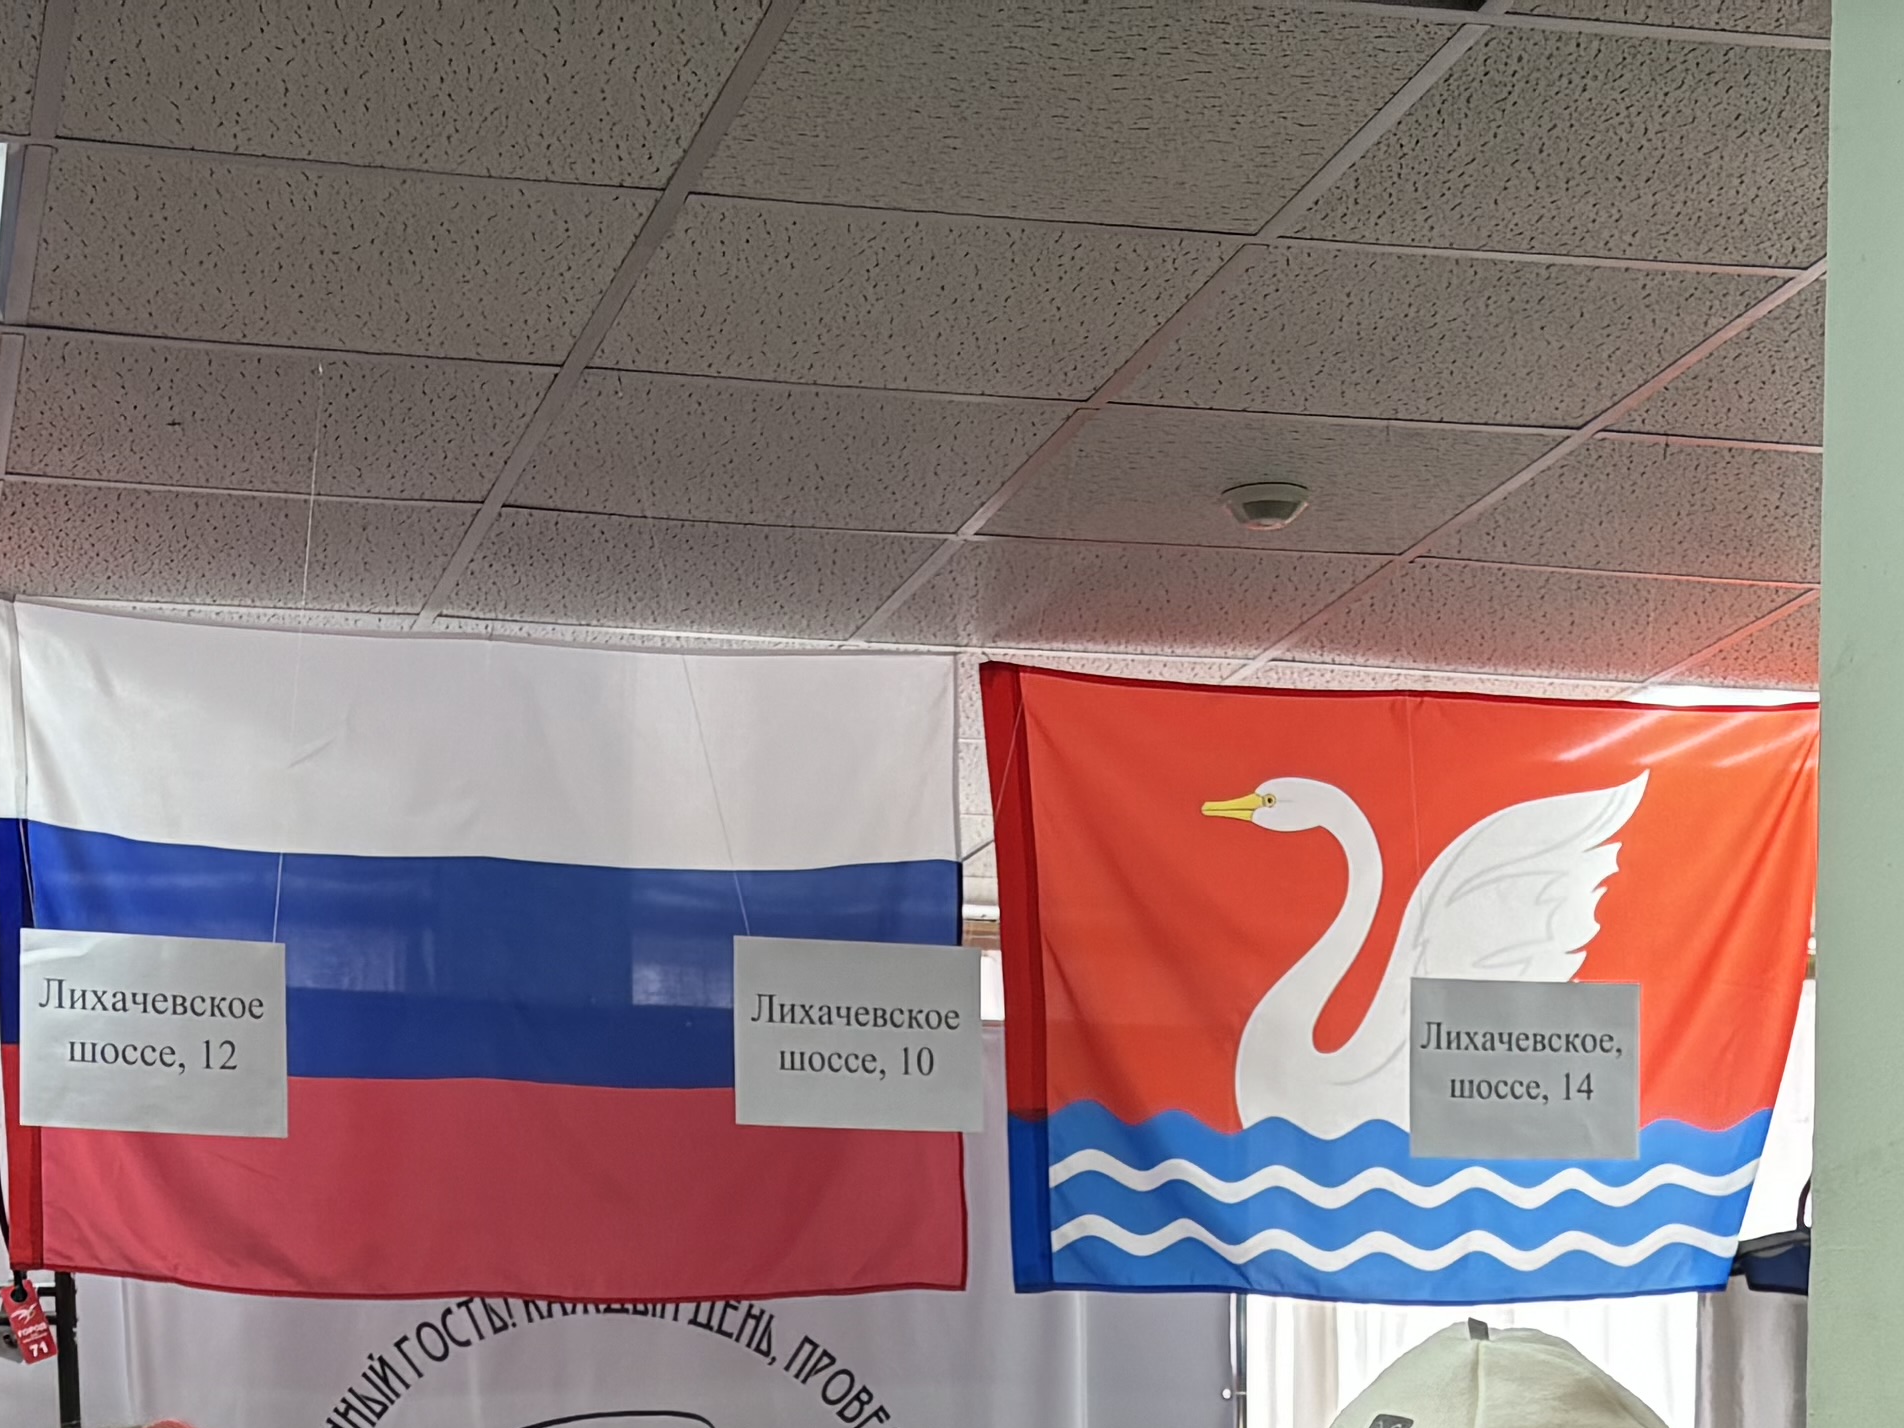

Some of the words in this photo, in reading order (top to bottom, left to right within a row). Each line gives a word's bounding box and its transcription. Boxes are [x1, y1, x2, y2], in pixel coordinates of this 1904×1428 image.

[38, 976, 266, 1021] Лихачевское
[750, 991, 961, 1033] Лихачевское
[66, 1039, 187, 1076] шоссе,
[199, 1038, 239, 1072] 12
[1420, 1021, 1622, 1059] Лихачевское,
[777, 1048, 889, 1080] шоссе,
[900, 1047, 936, 1077] 10
[1449, 1077, 1549, 1105] шоссе,
[1563, 1072, 1594, 1100] 14
[28, 1343, 49, 1357] 71
[393, 1297, 518, 1378] ГОСТЬ!
